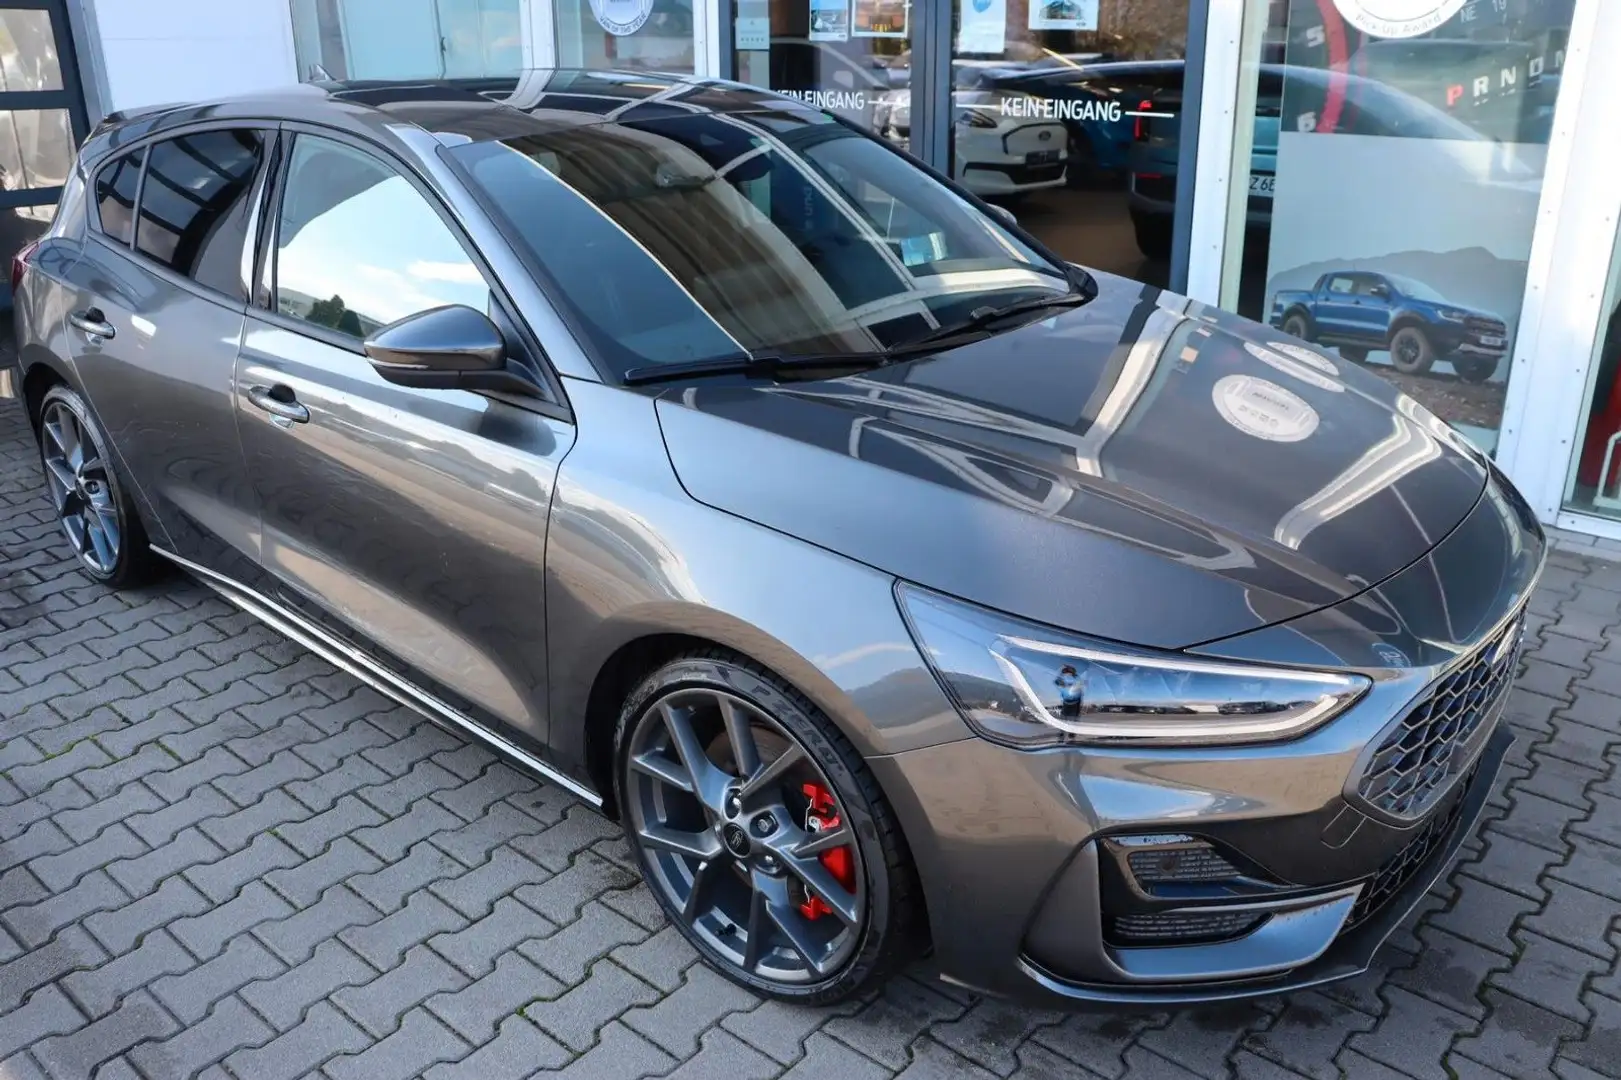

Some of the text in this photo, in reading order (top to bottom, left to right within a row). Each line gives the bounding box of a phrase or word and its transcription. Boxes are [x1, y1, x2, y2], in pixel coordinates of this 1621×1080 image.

[1446, 84, 1464, 106] P
[1473, 75, 1490, 97] R
[1500, 66, 1517, 88] N
[804, 90, 865, 110] EINGANG
[1001, 97, 1121, 122] KEIN EINGANG
